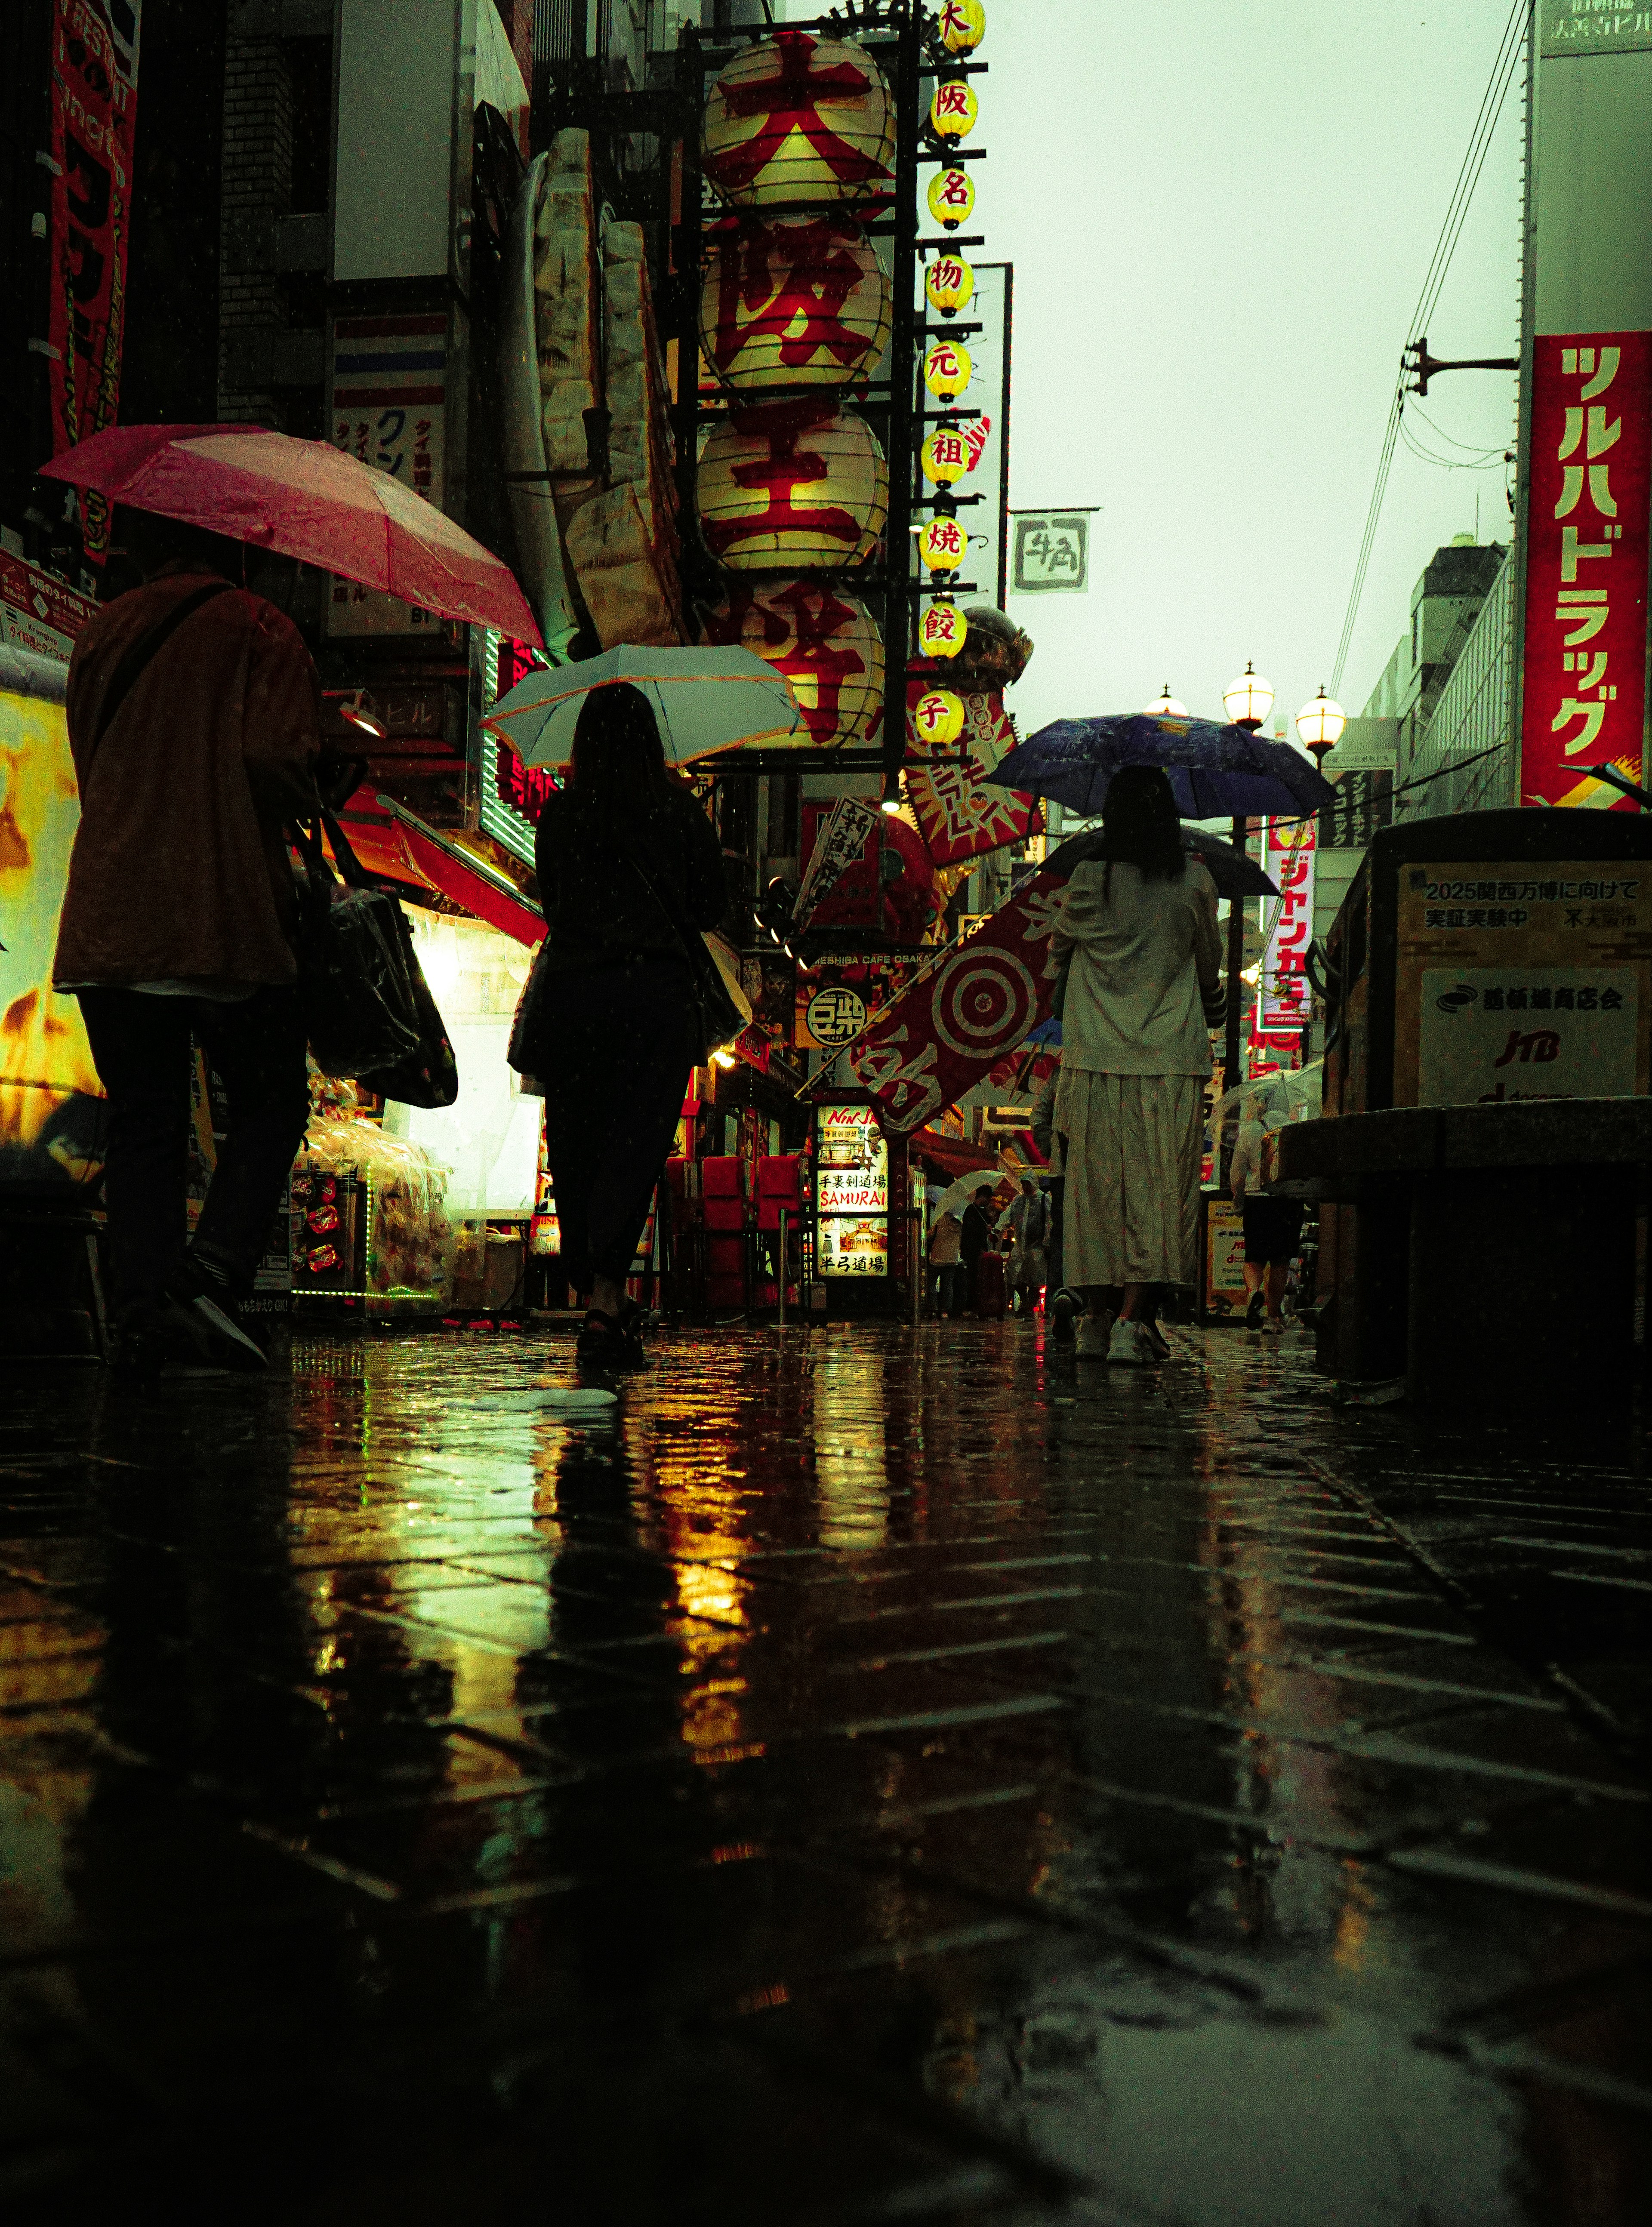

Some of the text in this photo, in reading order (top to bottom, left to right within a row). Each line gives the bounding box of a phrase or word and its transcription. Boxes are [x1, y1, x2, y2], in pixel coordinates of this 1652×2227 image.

[919, 2, 971, 727] 大阪名物元祖焼餃子
[1025, 532, 1078, 572] 牛角
[1550, 346, 1622, 756] ツルハドラッグ
[411, 607, 429, 623] B1
[1426, 880, 1639, 901] 2025関西万博に向けて
[1426, 908, 1528, 928] 実証実験中
[1277, 855, 1309, 1011] ジャンカラ
[862, 955, 891, 964] CAFE
[894, 954, 931, 964] OSAKA
[1495, 1030, 1561, 1068] JTB
[819, 1174, 887, 1188] 手裏剣道場
[820, 1191, 885, 1207] SAMURAI
[820, 1256, 885, 1272] 半弓道場
